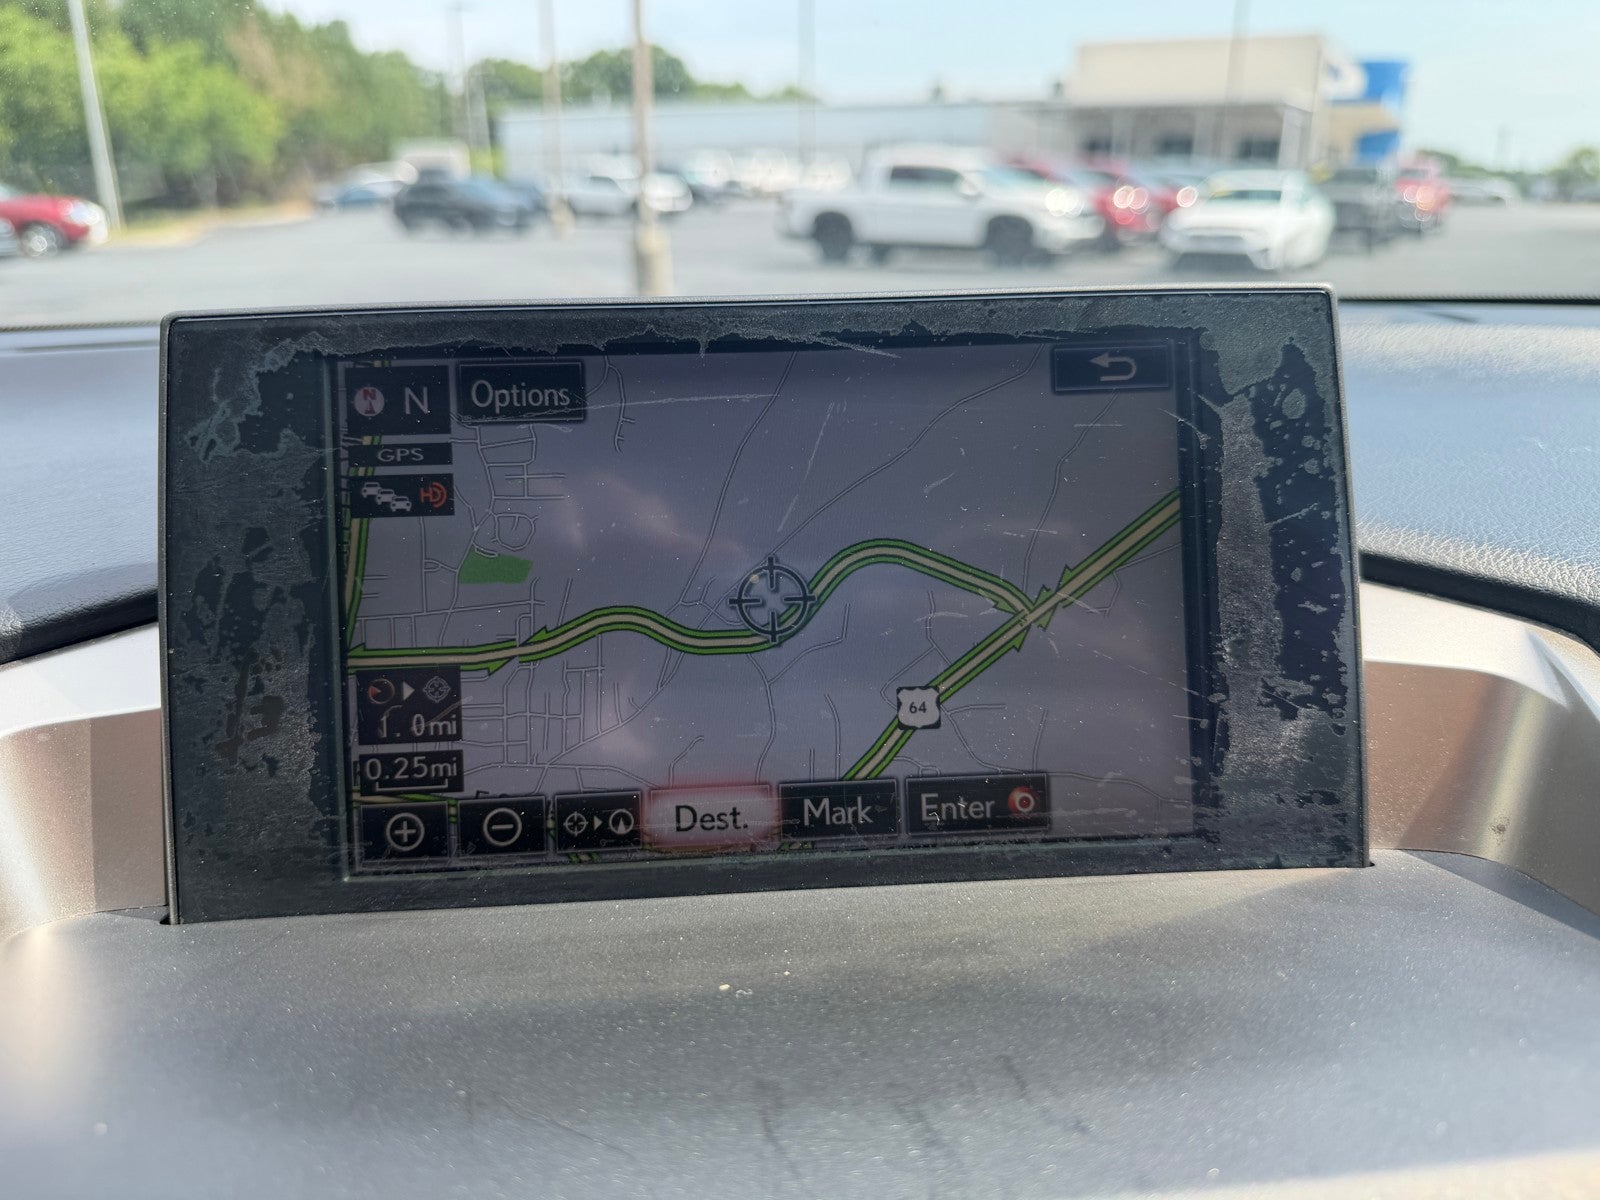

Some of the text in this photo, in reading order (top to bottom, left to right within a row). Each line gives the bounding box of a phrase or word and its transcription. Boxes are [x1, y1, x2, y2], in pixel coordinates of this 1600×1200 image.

[405, 386, 429, 415] N
[470, 379, 571, 414] Options
[377, 448, 425, 462] GPS
[909, 701, 927, 714] 64
[365, 756, 457, 780] 0.25mi
[675, 805, 749, 832] Dest.
[803, 796, 874, 826] Mark
[920, 793, 995, 821] Enter
